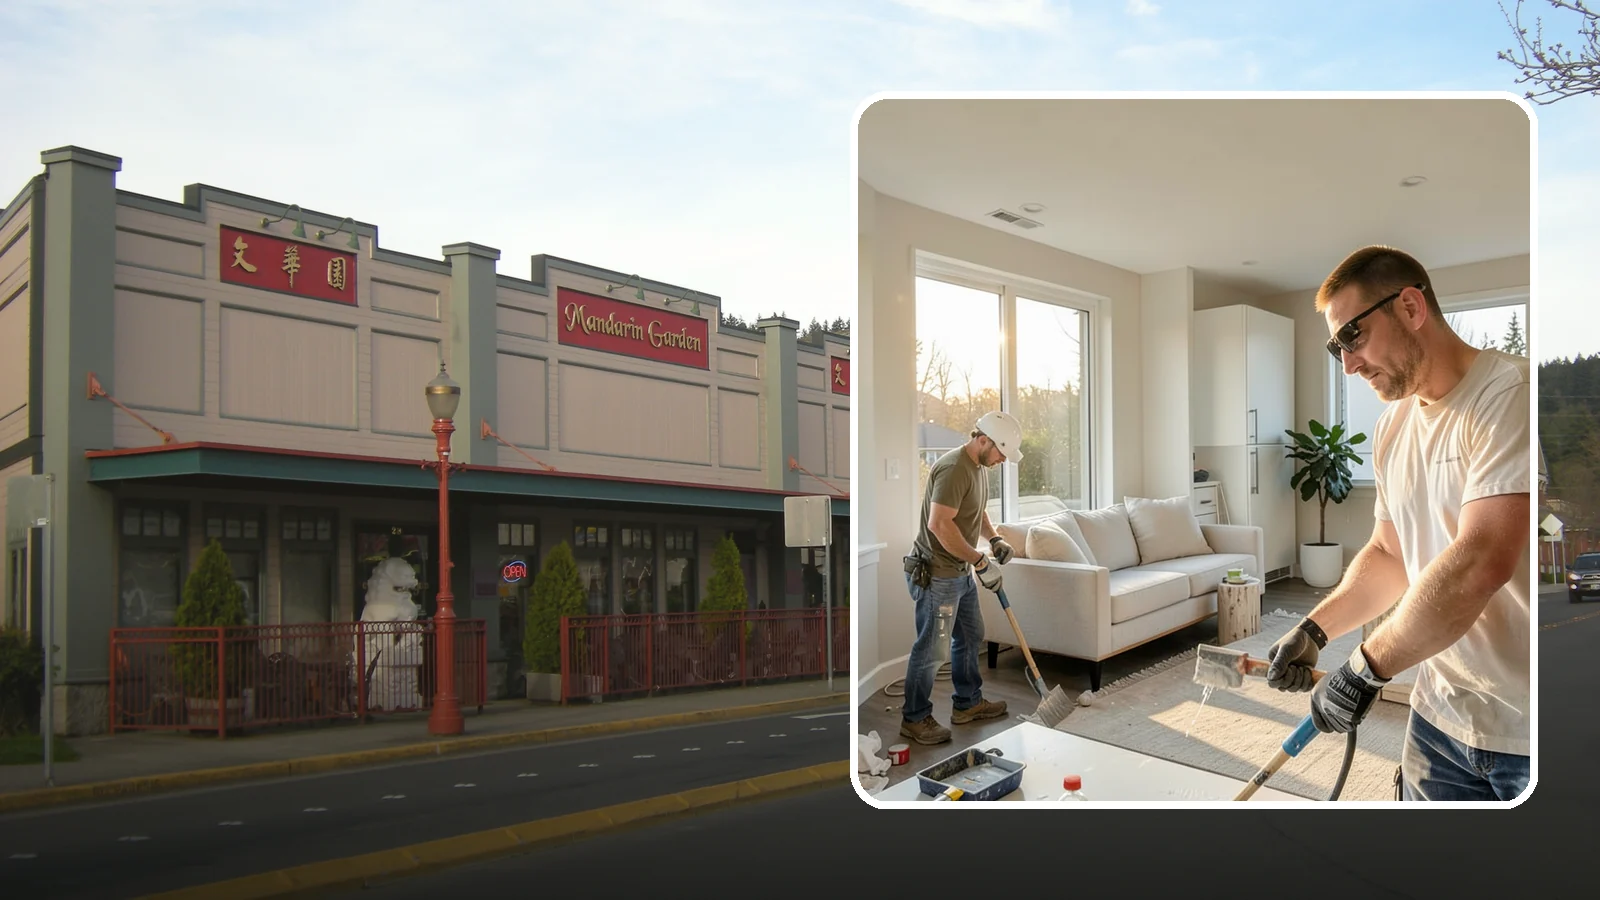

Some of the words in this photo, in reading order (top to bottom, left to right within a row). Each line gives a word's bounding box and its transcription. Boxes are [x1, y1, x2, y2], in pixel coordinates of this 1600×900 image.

[231, 236, 346, 290] 文華園
[564, 302, 644, 341] Mandarin
[648, 320, 701, 352] Garden
[503, 565, 527, 578] OPEN
